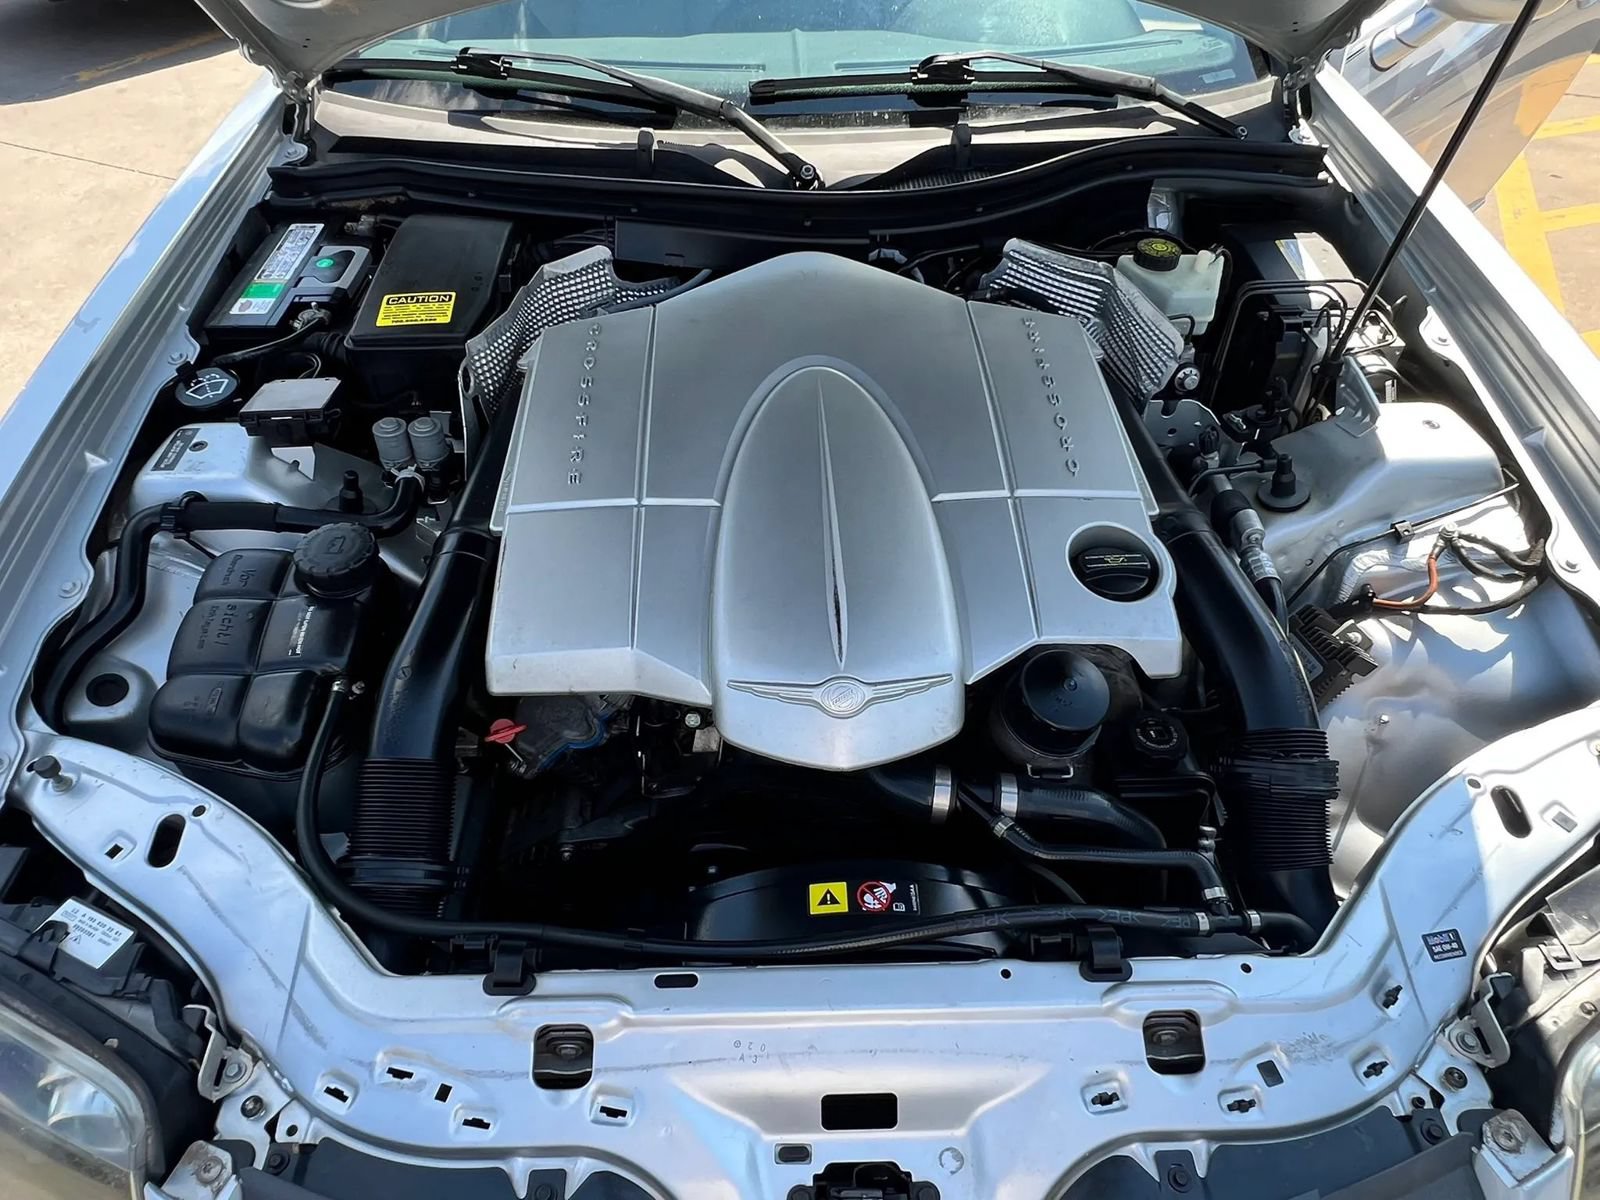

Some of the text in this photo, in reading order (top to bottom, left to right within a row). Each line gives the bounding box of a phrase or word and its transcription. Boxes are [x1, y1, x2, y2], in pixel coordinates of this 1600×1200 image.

[388, 295, 450, 305] CAUTION
[568, 322, 601, 485] CROSSFIRE
[1022, 317, 1080, 477] CROSSFIRE
